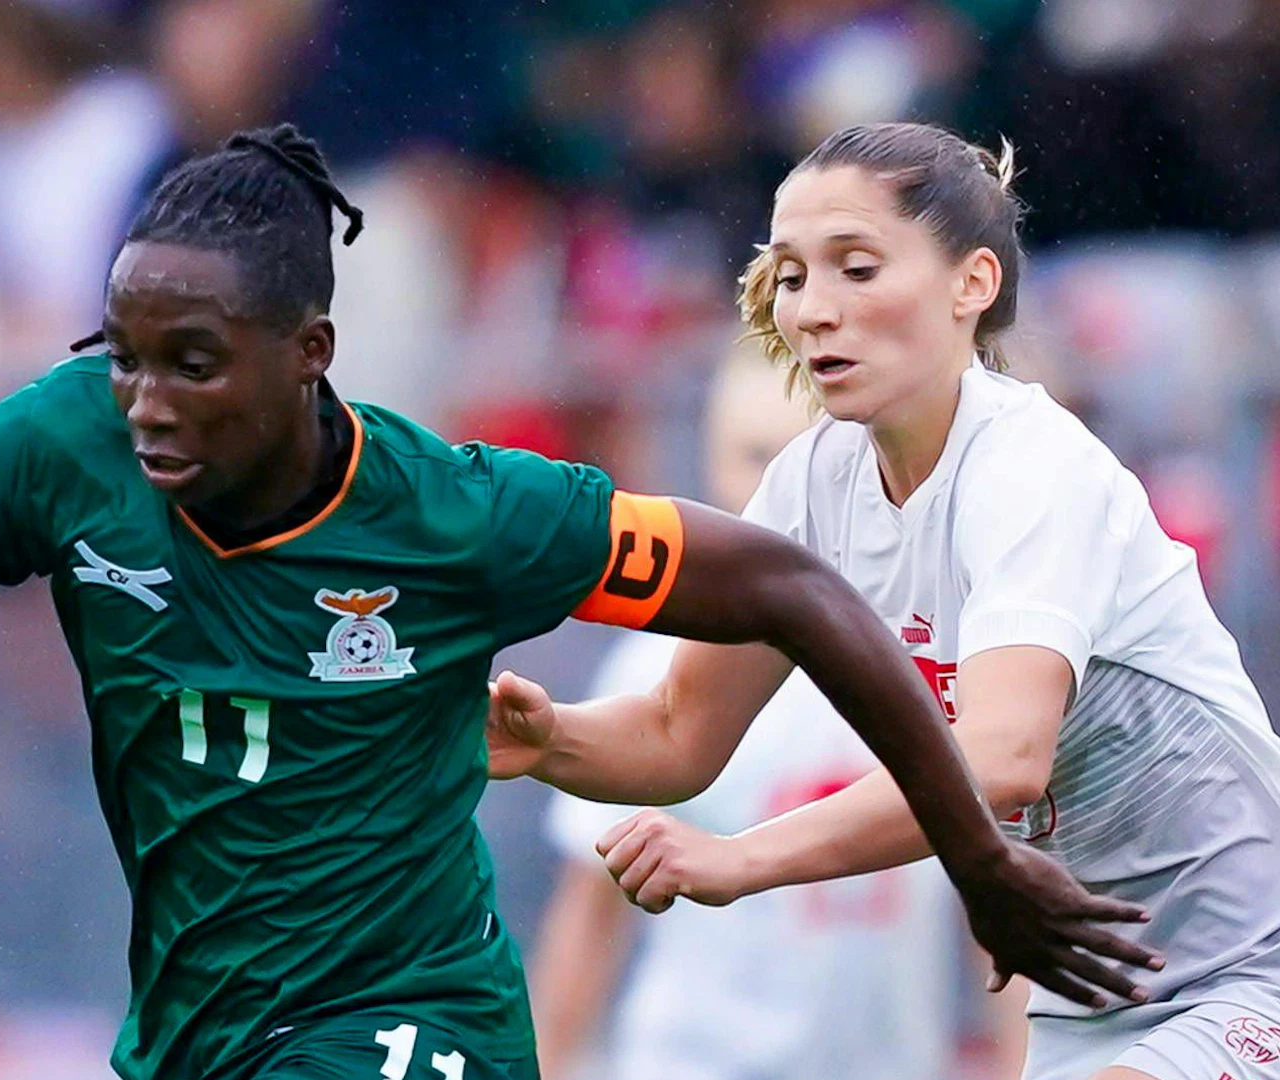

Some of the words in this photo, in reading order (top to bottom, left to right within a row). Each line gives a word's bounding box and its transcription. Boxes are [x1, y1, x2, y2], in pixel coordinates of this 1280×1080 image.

[604, 530, 668, 600] C
[338, 666, 385, 675] ZAMBIA
[162, 687, 270, 783] 11
